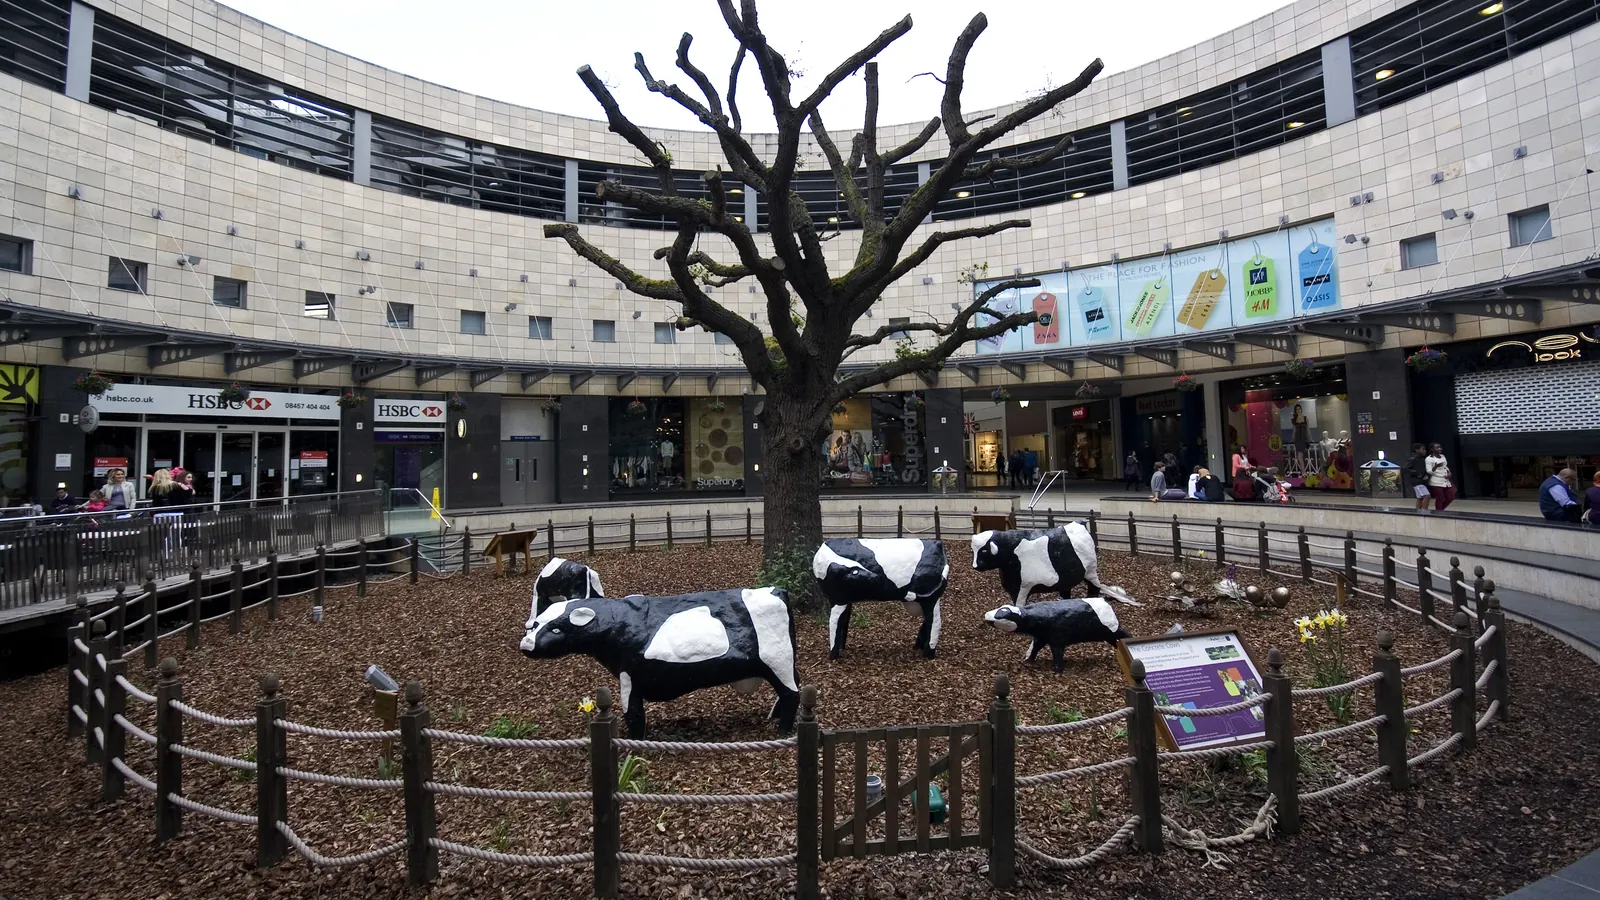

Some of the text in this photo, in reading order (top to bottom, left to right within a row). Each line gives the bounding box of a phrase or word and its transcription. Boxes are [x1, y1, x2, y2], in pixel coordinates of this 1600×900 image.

[1088, 256, 1206, 281] THE PLACE FOR FASHION
[1252, 270, 1265, 281] GAP
[1247, 287, 1273, 297] HOBBS
[1306, 293, 1330, 303] OASIS
[1146, 302, 1160, 325] AZENDI
[1534, 348, 1582, 362] look
[106, 395, 154, 403] hsbc.co.uk
[285, 402, 305, 410] 08457
[378, 404, 420, 417] HSBC
[1130, 642, 1180, 653] The Concrete Cows
